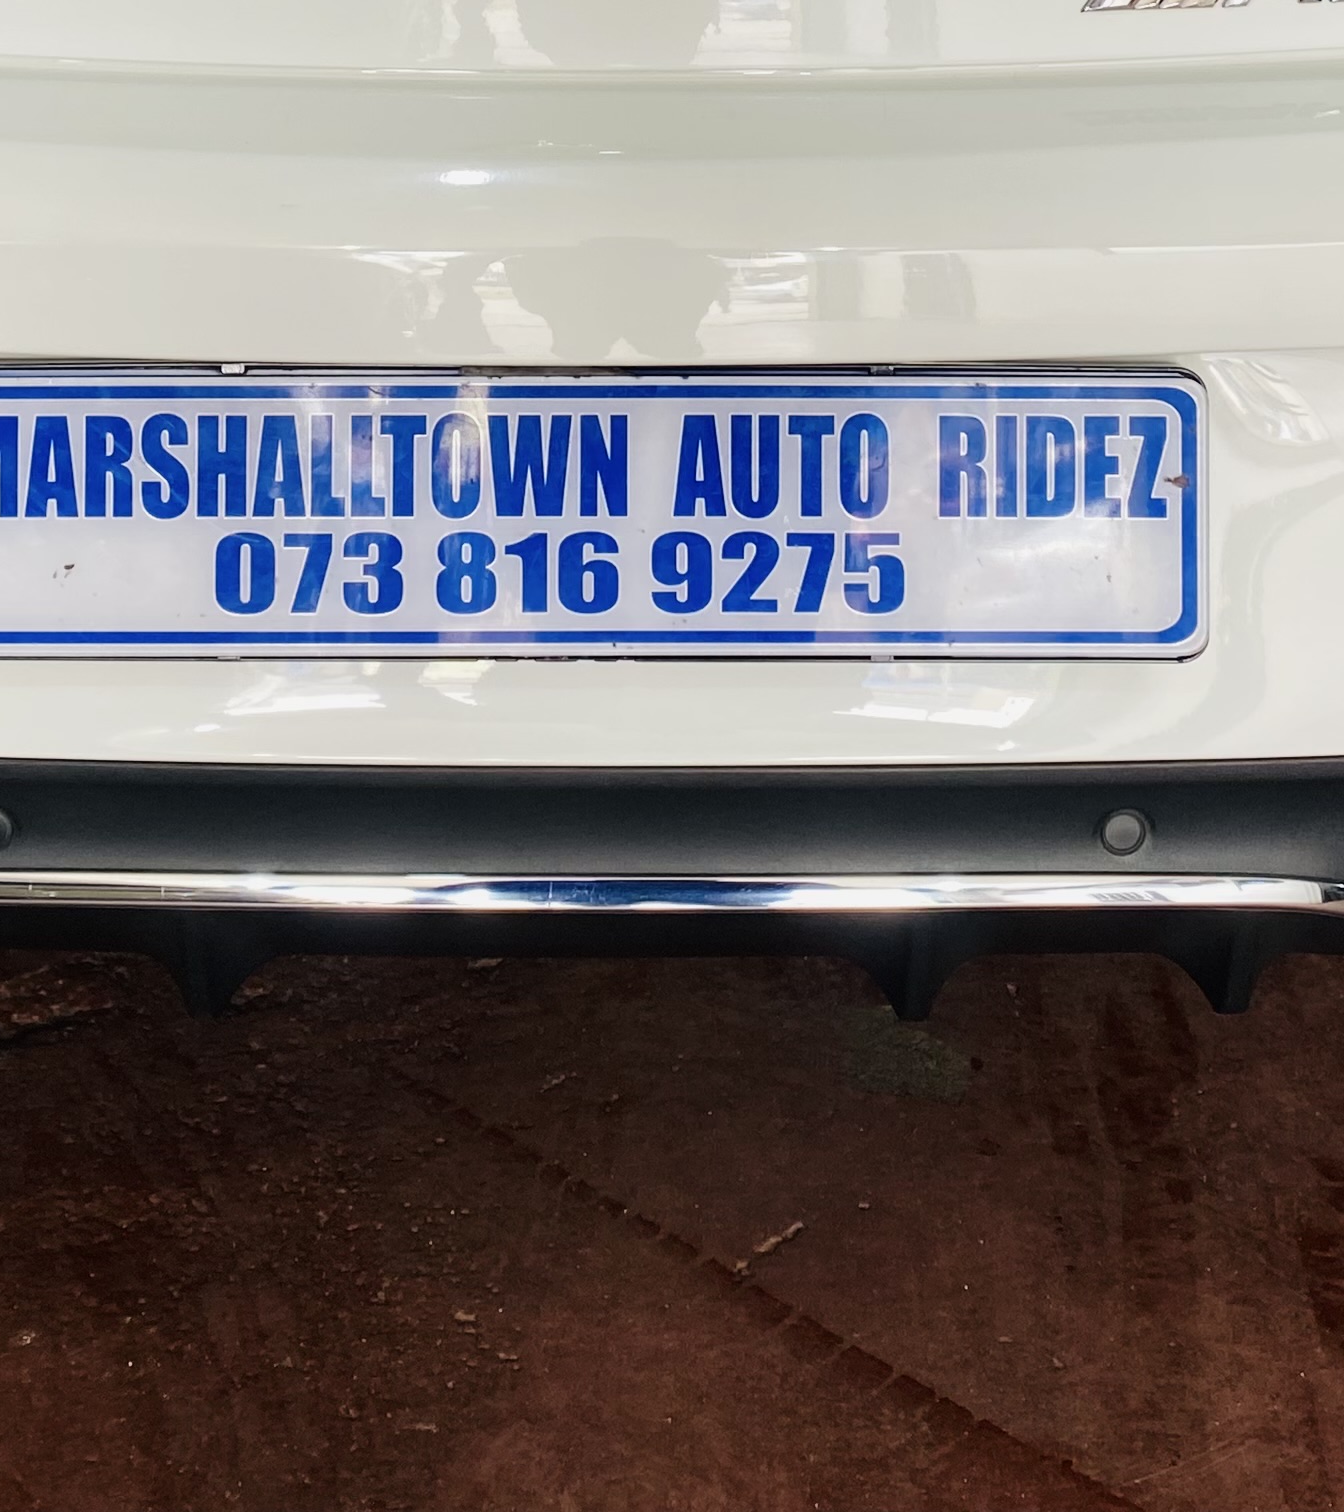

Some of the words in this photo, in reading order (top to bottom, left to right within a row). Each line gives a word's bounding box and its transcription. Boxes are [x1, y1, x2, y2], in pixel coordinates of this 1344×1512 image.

[671, 412, 890, 520] AUTO
[938, 415, 1169, 520] RIDEZ
[214, 530, 404, 615] 073
[435, 530, 620, 615] 816
[649, 530, 906, 615] 9275
